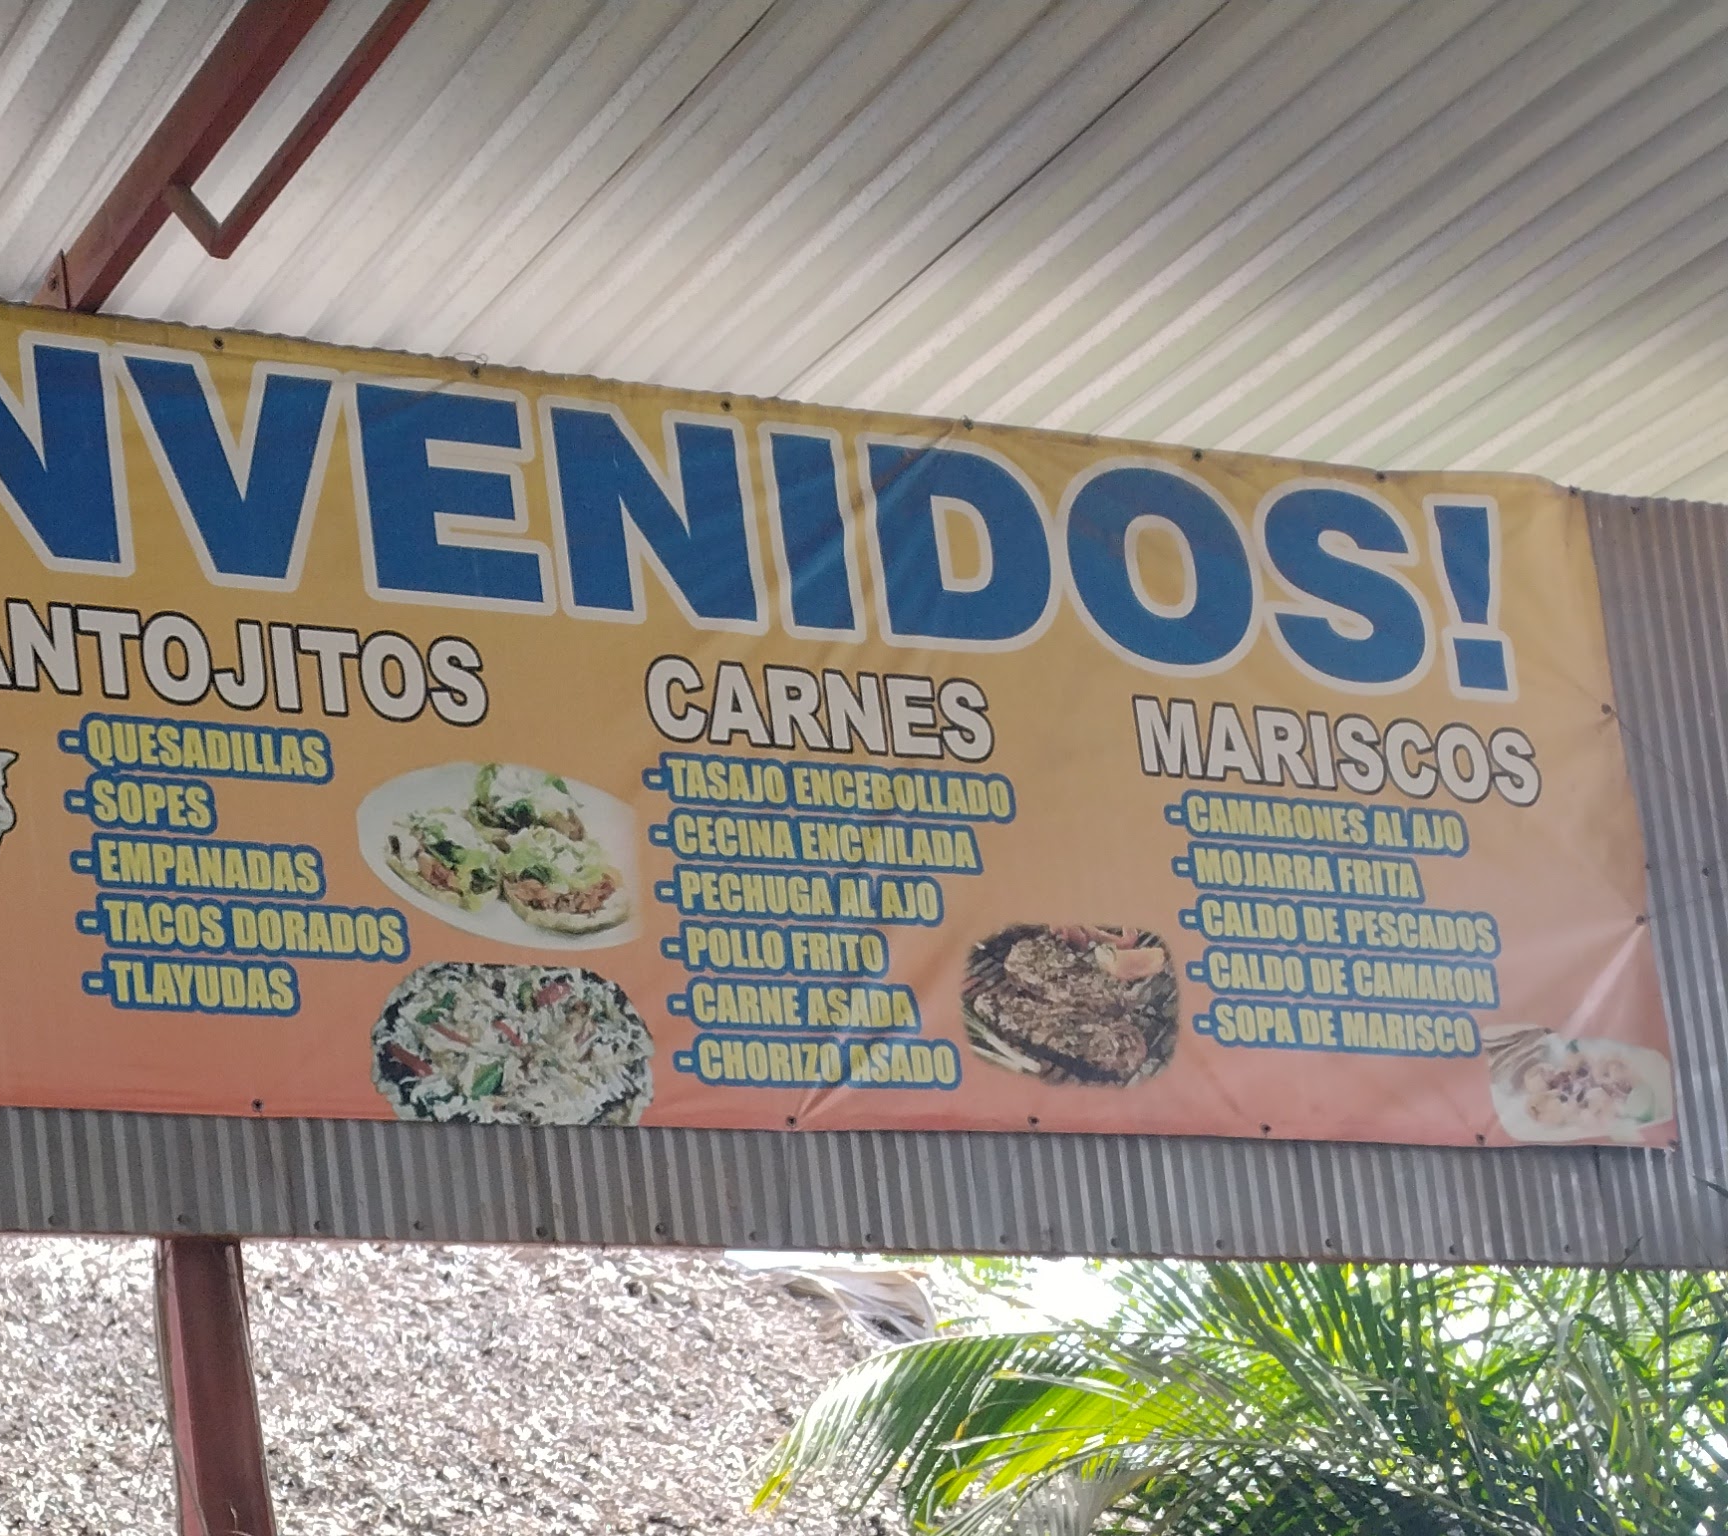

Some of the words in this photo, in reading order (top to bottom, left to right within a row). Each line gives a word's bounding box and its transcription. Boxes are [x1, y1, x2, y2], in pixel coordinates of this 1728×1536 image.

[644, 655, 995, 763] CARNES
[84, 717, 330, 780] QUESADILLAS
[1132, 694, 1542, 807] MARISCOS
[89, 777, 213, 831] SOPES
[665, 757, 788, 805] TASAJO
[790, 764, 1012, 820] ENCEBOLLADO
[672, 812, 797, 861] CECINA
[797, 820, 979, 870] ENCHILADA
[1185, 794, 1370, 845] CAMARONES
[1372, 808, 1410, 849] AL
[1411, 812, 1466, 853] AJO
[95, 837, 322, 895] EMPANADAS
[1192, 845, 1337, 894] MOJARRA
[1335, 855, 1422, 900] FRITA
[677, 868, 835, 918] PECHUGA
[837, 875, 877, 920] AL
[879, 879, 940, 923] AJO
[101, 898, 227, 949] TACOS
[230, 905, 406, 959] DORADOS
[684, 924, 787, 970] POLLO
[789, 930, 886, 975] FRITO
[1199, 898, 1300, 943] CALDO
[1301, 904, 1343, 945] DE
[1343, 907, 1498, 955] PESCADOS
[106, 958, 296, 1012] TLAYUDAS
[690, 982, 803, 1027] CARNE
[805, 985, 918, 1030] ASADA
[1206, 950, 1307, 994] CALDO
[1308, 956, 1350, 997] DE
[1350, 959, 1498, 1006] CAMARON
[1213, 1002, 1297, 1046] SOPA
[1296, 1006, 1339, 1048] DE
[1338, 1008, 1478, 1055] MARISCO
[696, 1037, 843, 1085] CHORIZO
[847, 1042, 959, 1085] ASADO
